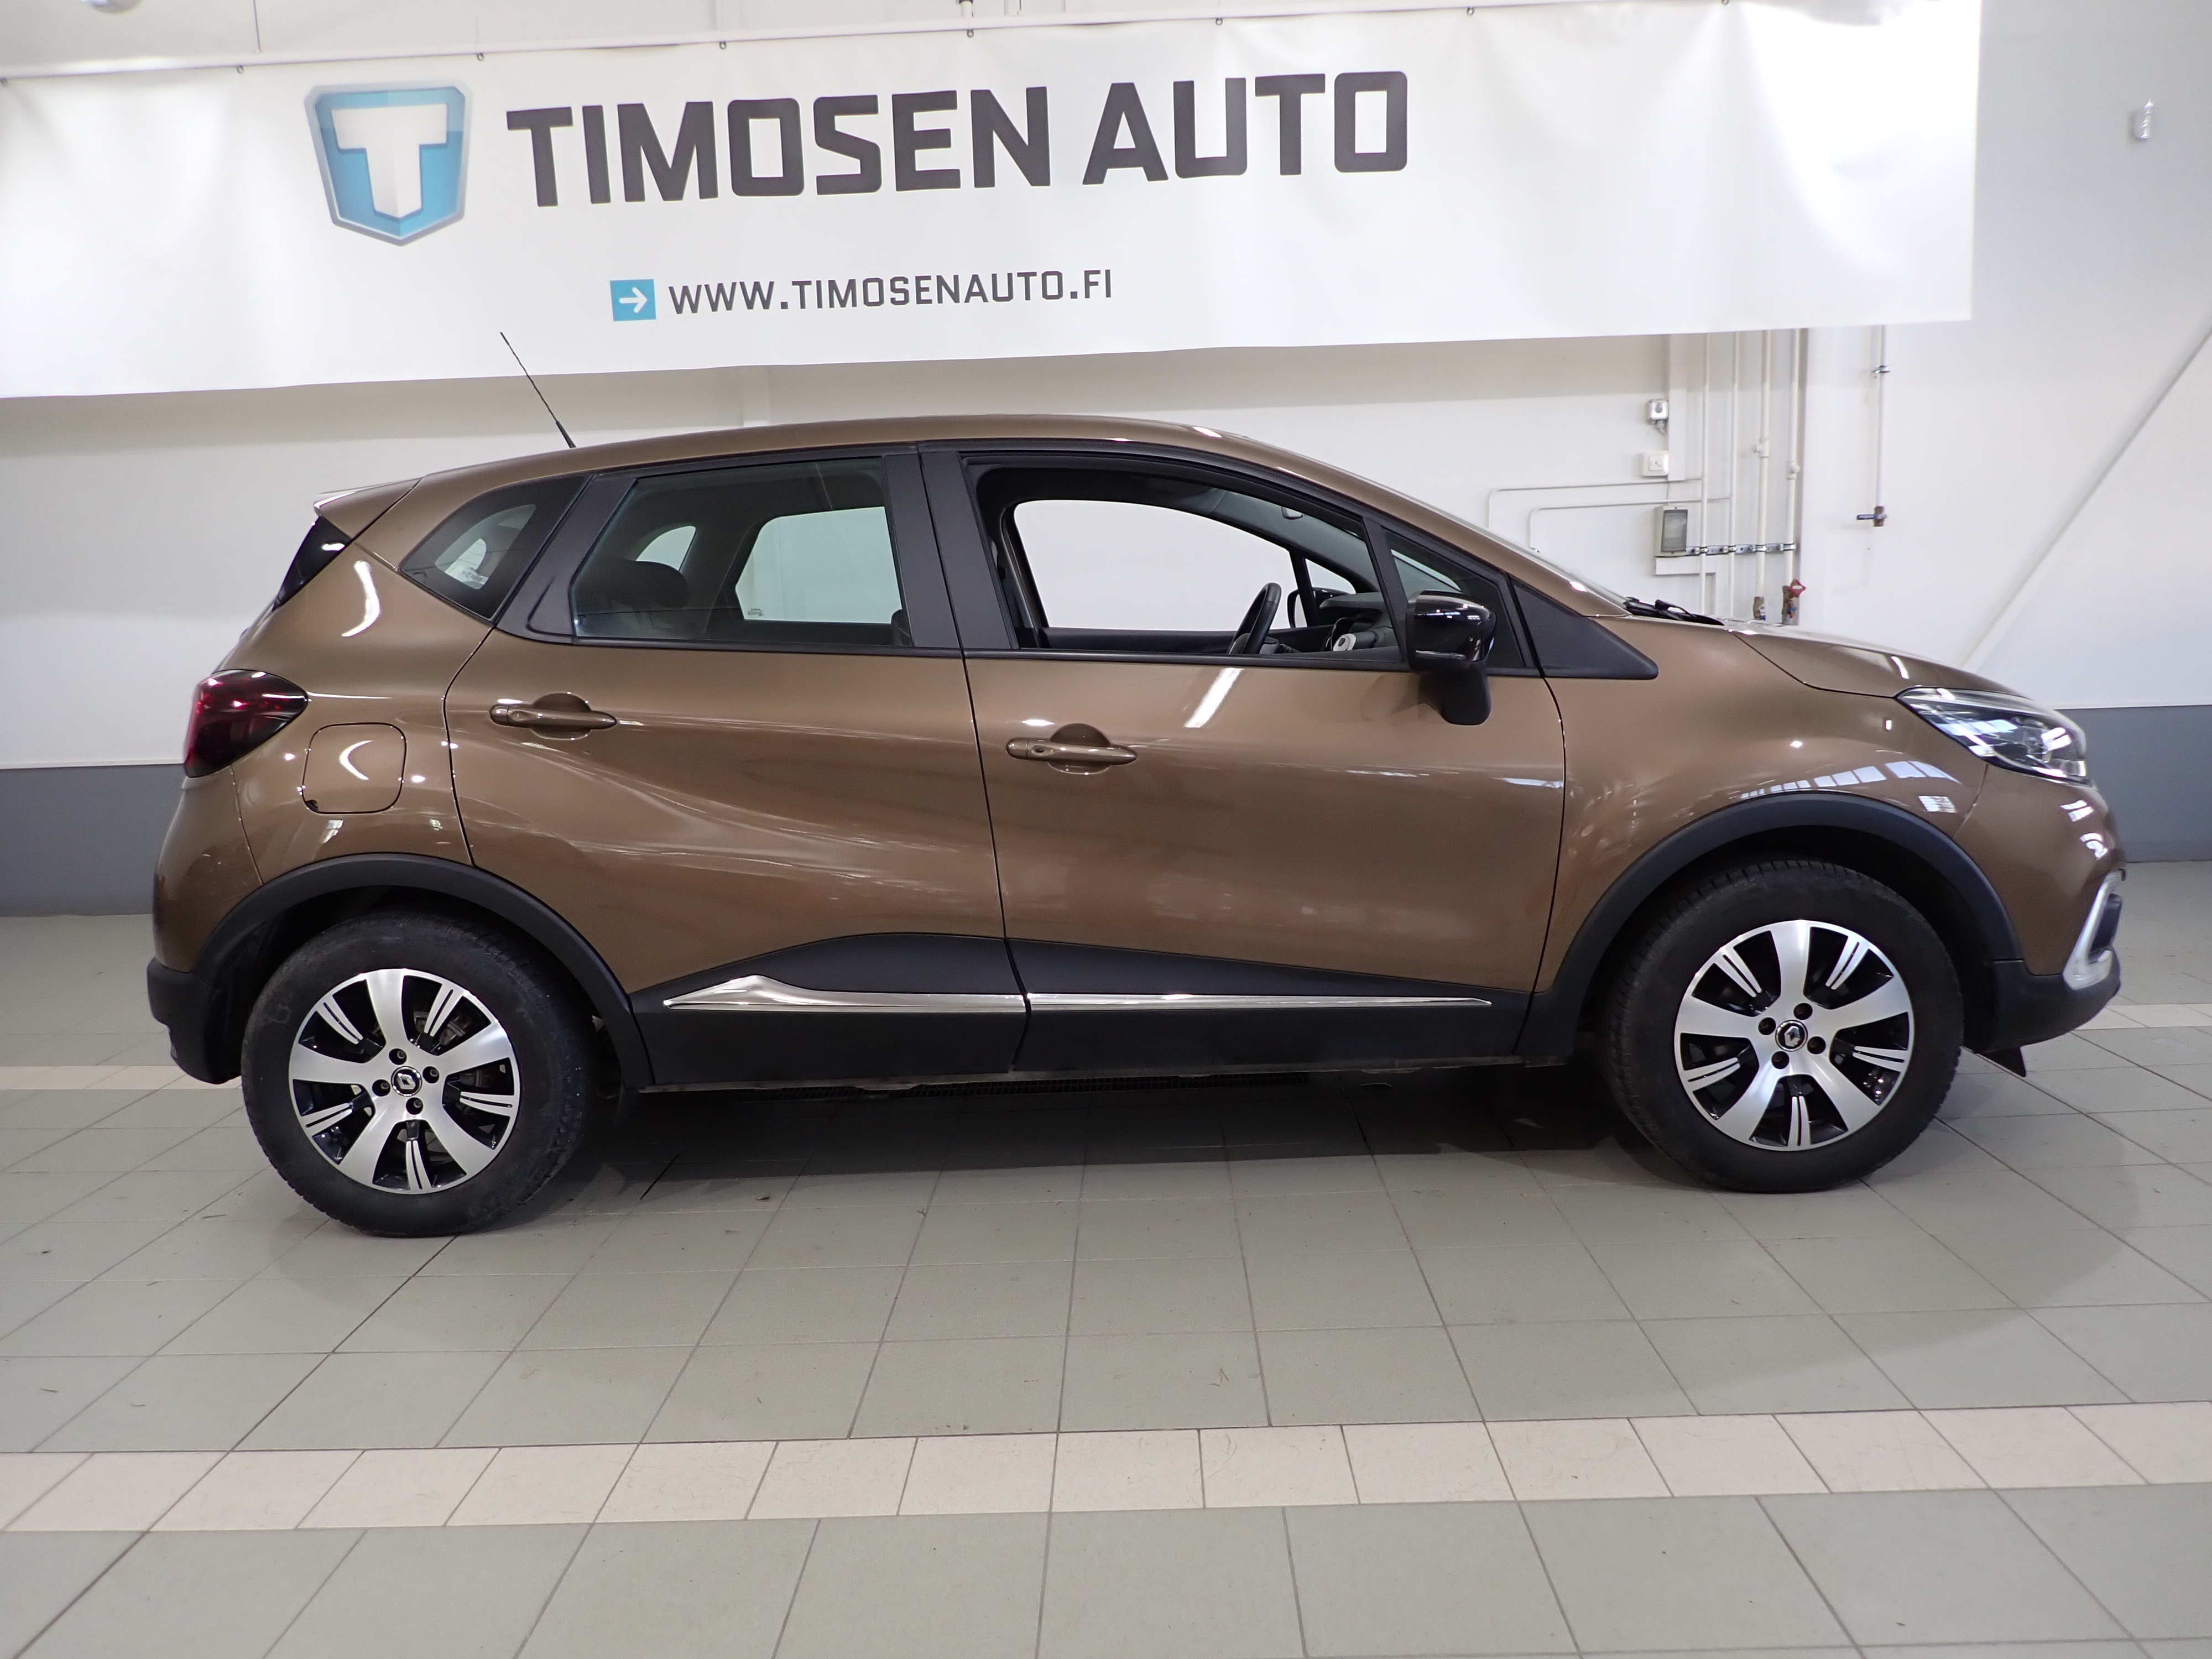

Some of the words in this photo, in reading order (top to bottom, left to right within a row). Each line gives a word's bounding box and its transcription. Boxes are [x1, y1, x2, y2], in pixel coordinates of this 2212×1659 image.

[332, 103, 447, 218] T
[506, 86, 1051, 207] TIMOSEN
[1082, 71, 1407, 185] AUTO
[668, 269, 1111, 315] WWW.TIMOSENAUTO.FI
